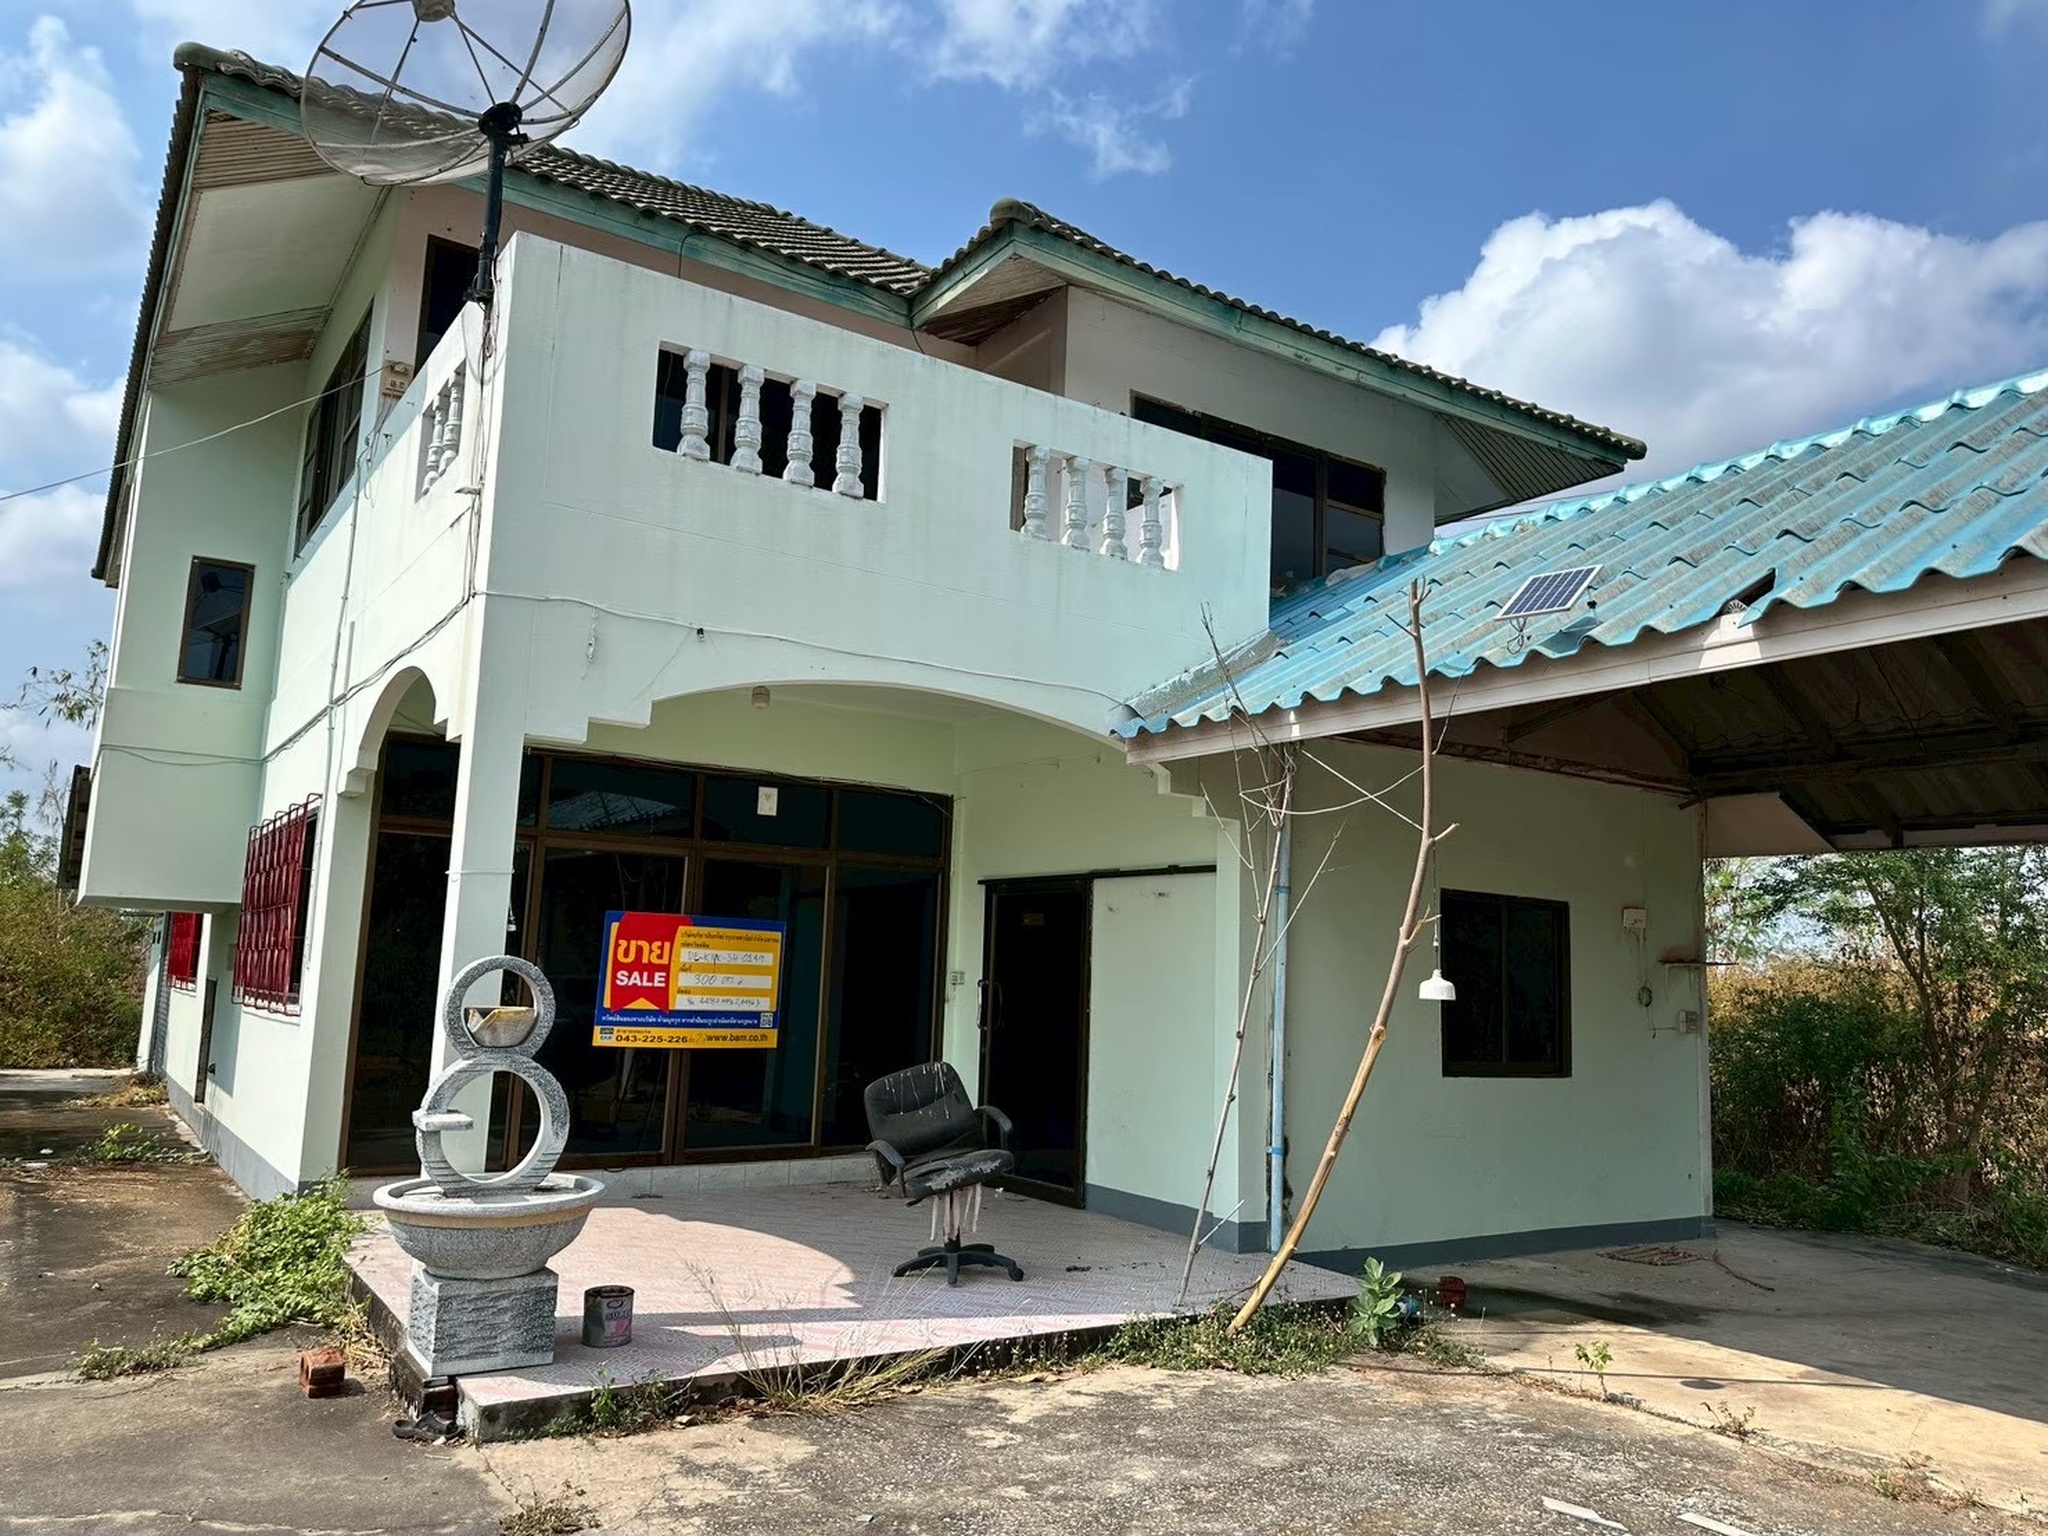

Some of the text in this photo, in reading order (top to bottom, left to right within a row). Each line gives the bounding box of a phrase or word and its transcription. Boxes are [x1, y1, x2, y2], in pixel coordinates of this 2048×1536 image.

[617, 940, 671, 965] ขาย
[615, 970, 667, 987] SALE
[694, 974, 718, 986] 300
[706, 1033, 768, 1042] www.bam.co.th
